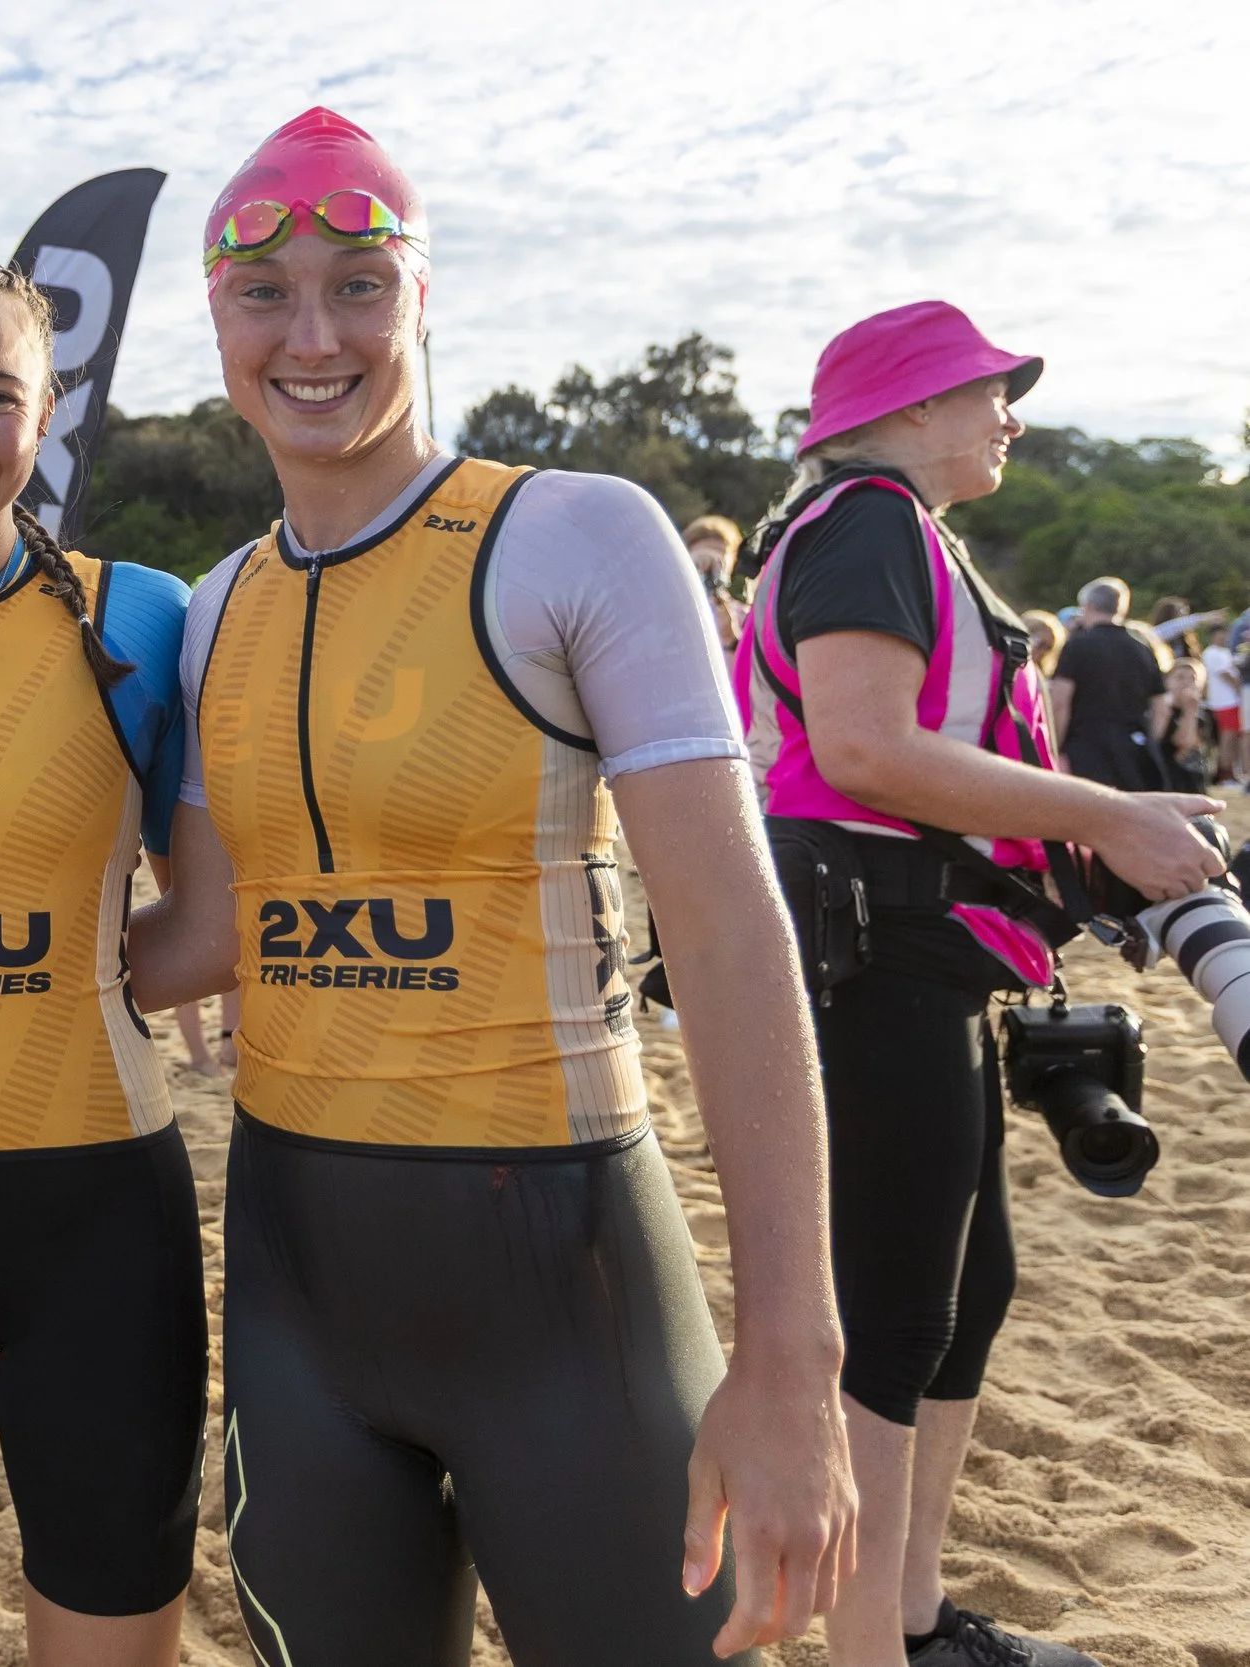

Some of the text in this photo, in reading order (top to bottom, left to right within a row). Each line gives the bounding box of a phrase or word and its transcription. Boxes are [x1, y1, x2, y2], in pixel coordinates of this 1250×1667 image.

[422, 513, 477, 533] 2XU
[258, 898, 455, 960] 2XU
[260, 963, 460, 992] TRI-SERIES
